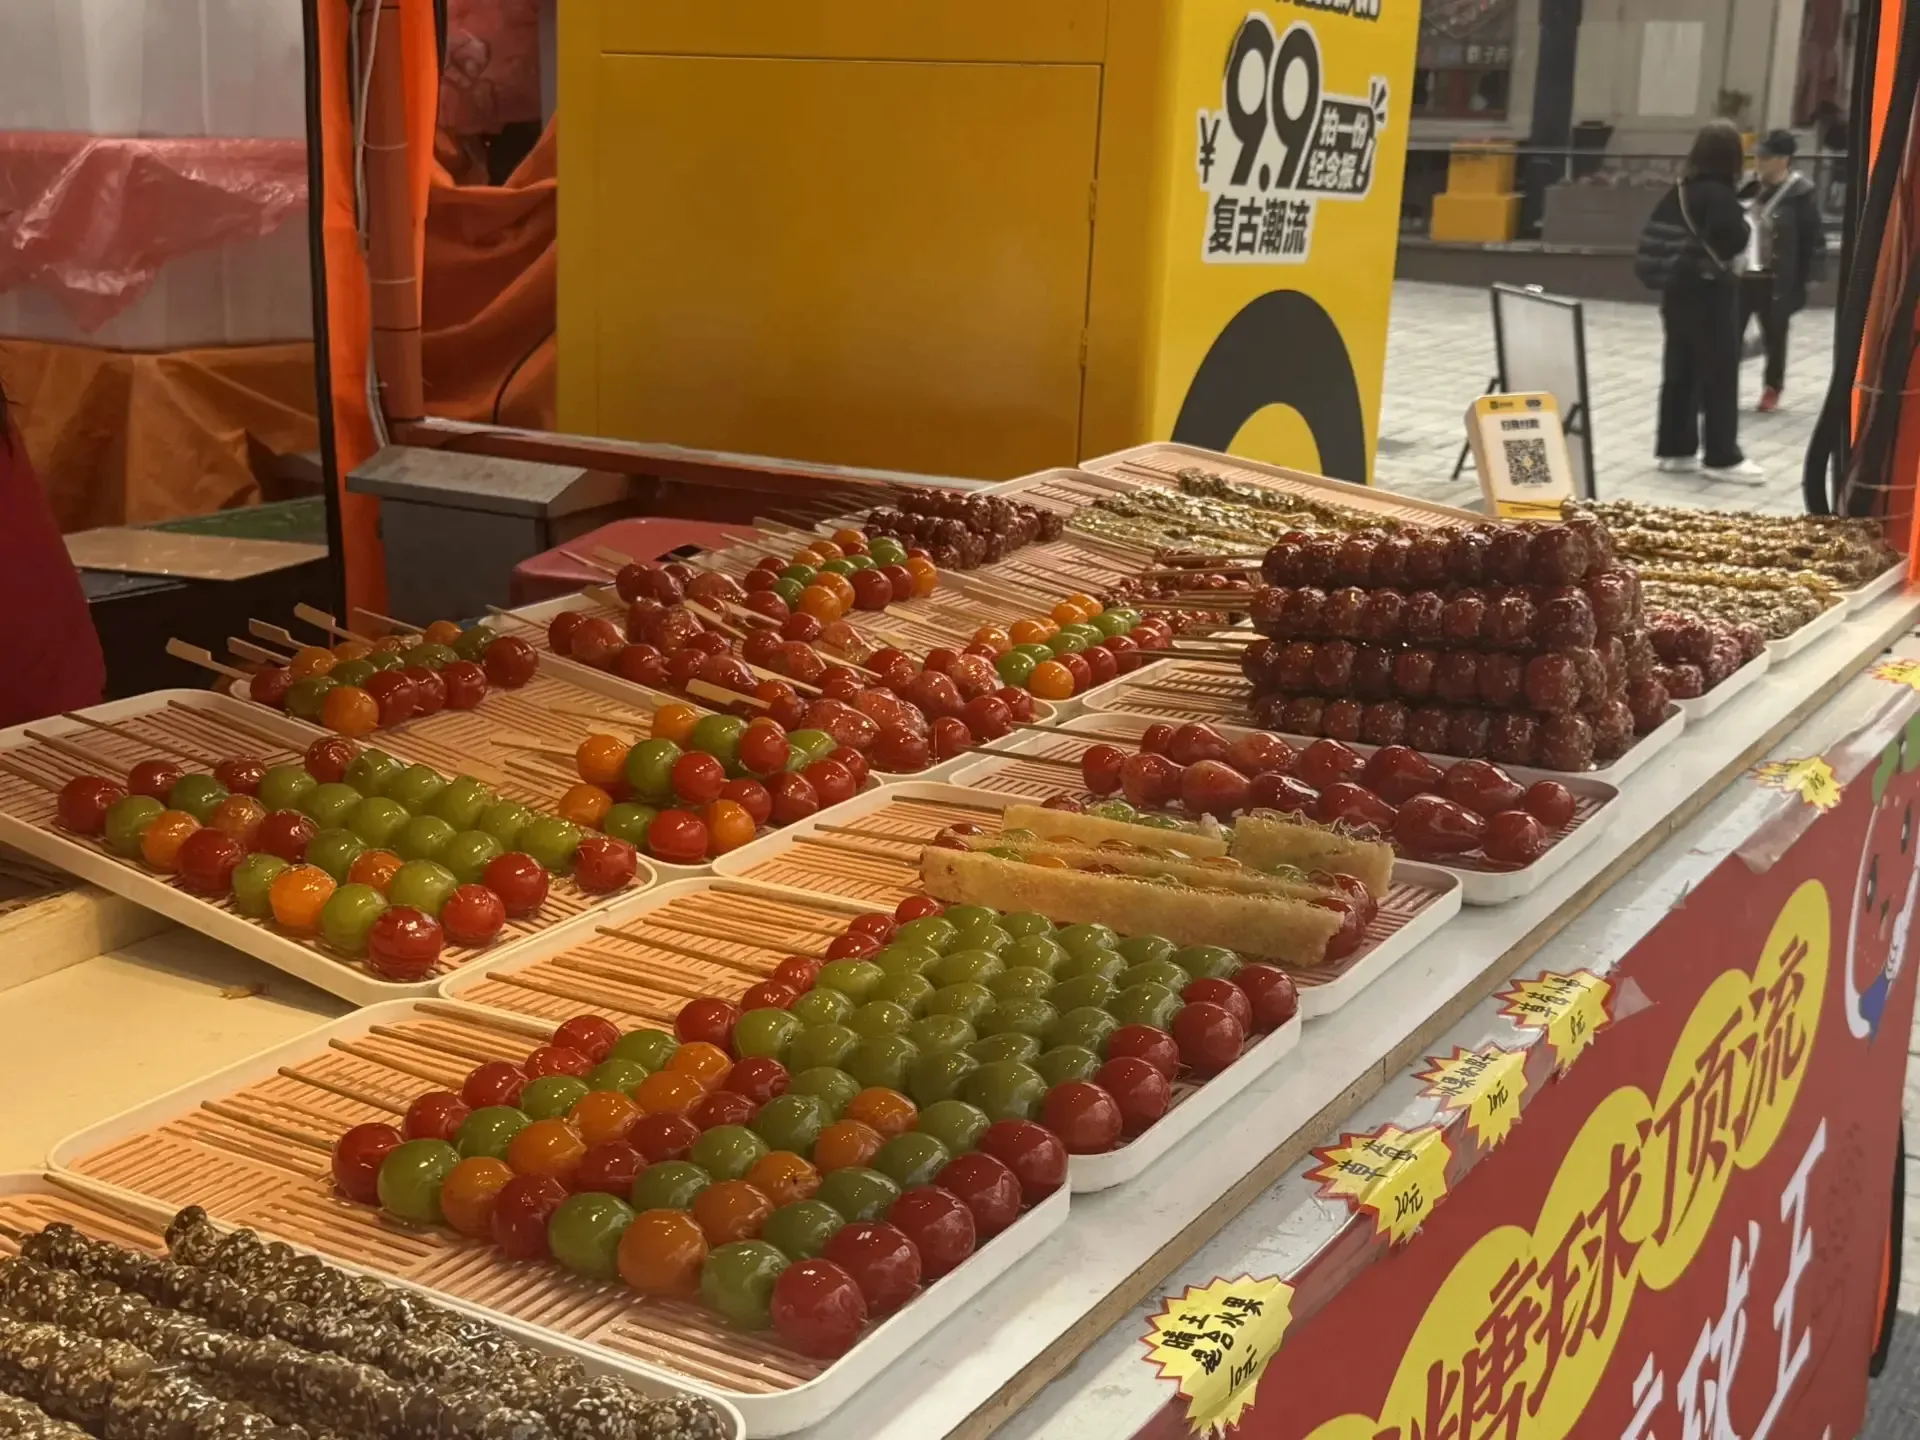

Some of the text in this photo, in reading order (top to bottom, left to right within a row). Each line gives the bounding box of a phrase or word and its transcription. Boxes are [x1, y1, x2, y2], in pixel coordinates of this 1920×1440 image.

[1207, 194, 1311, 254] 复古潮流
[1229, 1344, 1257, 1397] 10元
